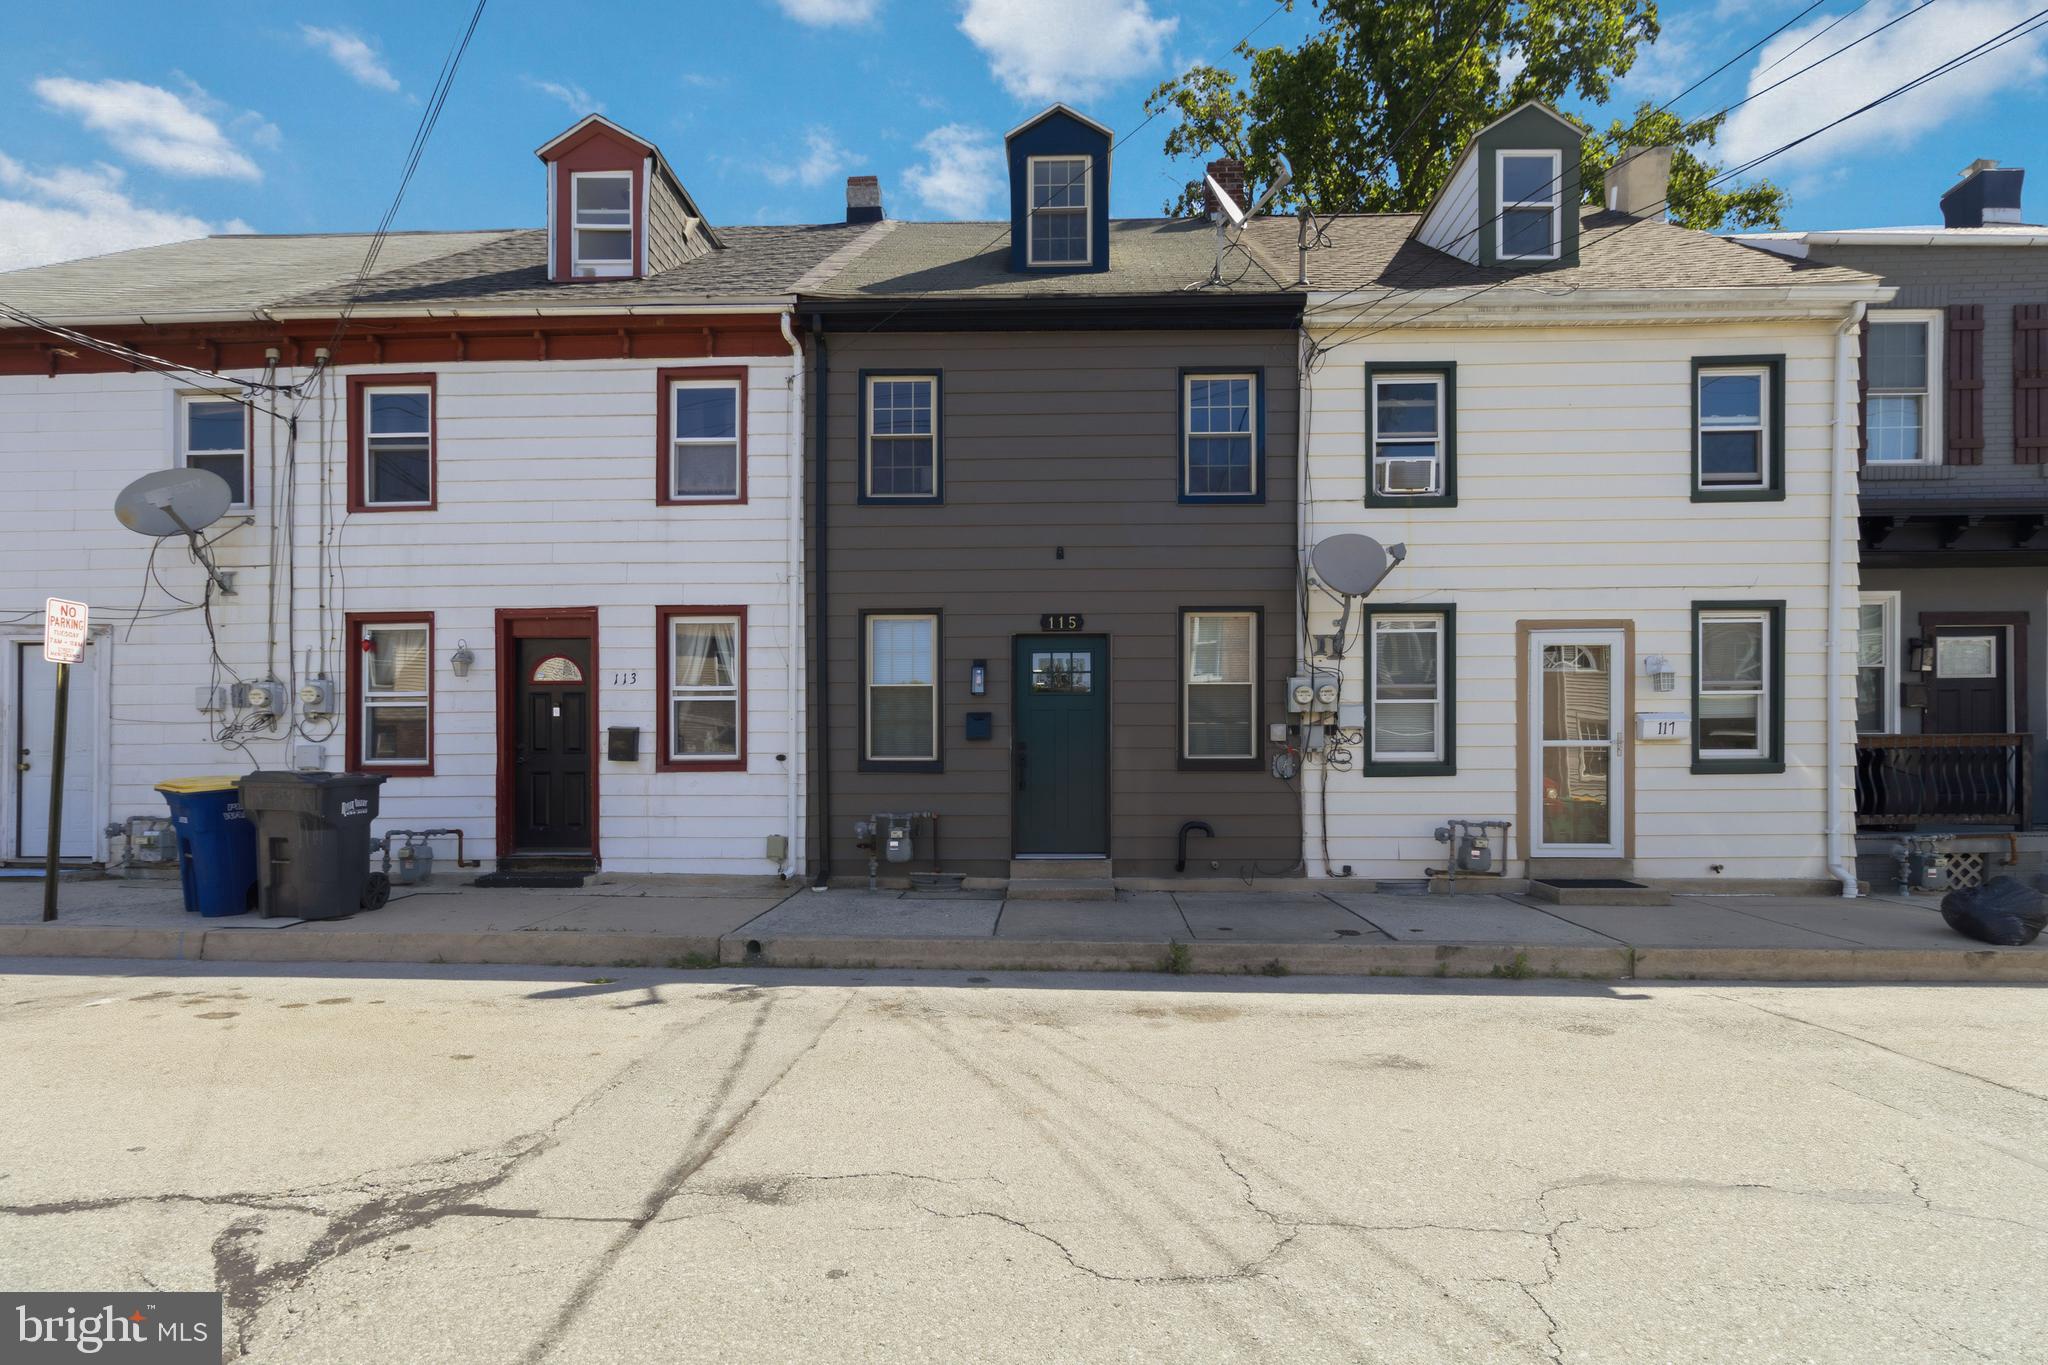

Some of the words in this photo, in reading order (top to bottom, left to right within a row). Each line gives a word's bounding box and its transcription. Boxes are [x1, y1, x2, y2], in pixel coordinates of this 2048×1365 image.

[60, 604, 76, 618] NO
[50, 615, 84, 631] PARKING
[1049, 615, 1077, 629] 115
[613, 672, 637, 686] 113
[1658, 721, 1675, 735] 117
